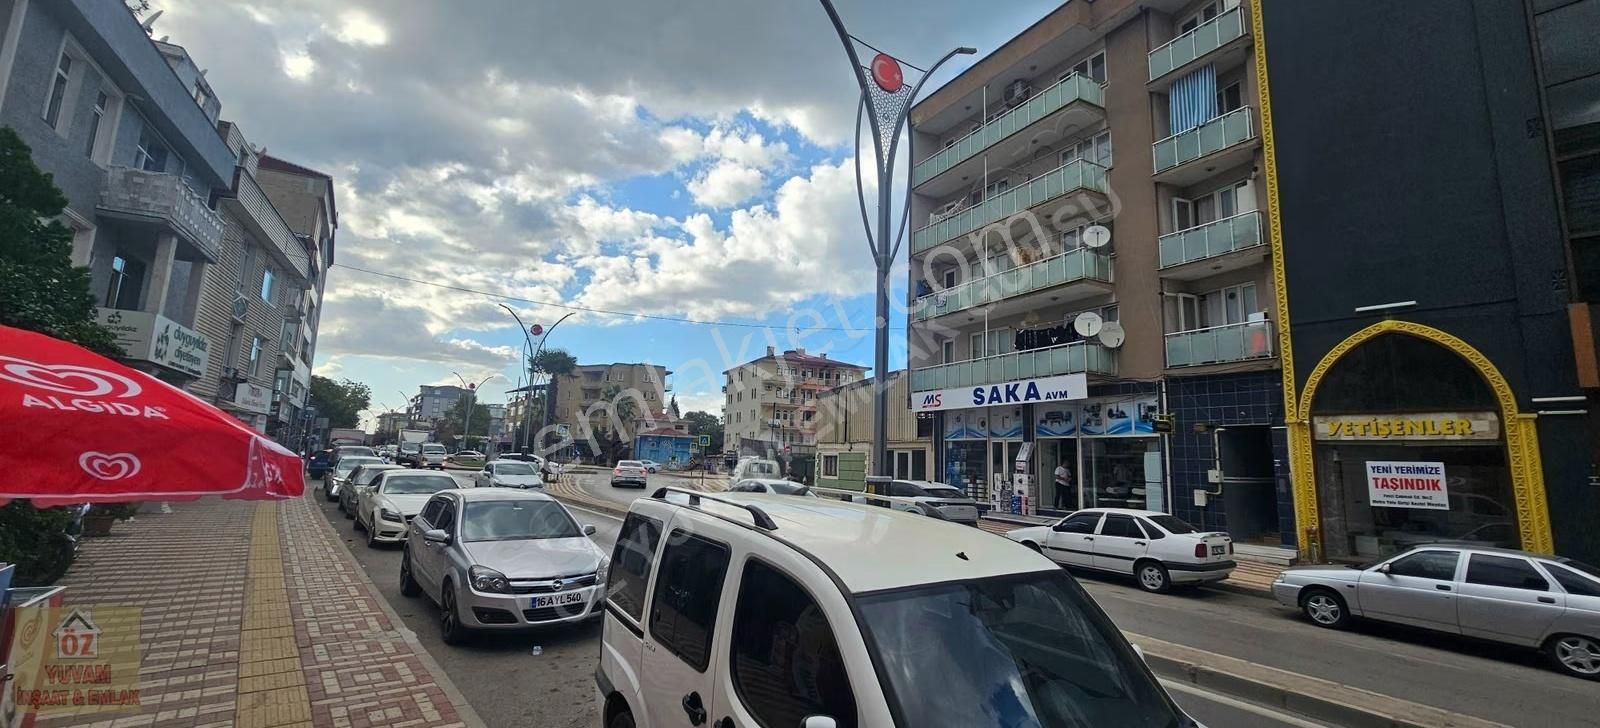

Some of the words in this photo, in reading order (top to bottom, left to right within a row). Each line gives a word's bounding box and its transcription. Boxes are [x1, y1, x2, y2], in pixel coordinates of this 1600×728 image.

[923, 394, 942, 407] MS
[973, 381, 1041, 406] SAKA
[1045, 390, 1068, 400] AVM
[1328, 416, 1474, 438] YETİŞENLER
[1371, 464, 1392, 474] YENİ
[1394, 465, 1441, 475] YERİMİZE
[1372, 477, 1442, 491] TAŞINDIK
[537, 598, 546, 607] 16
[567, 593, 581, 602] 540
